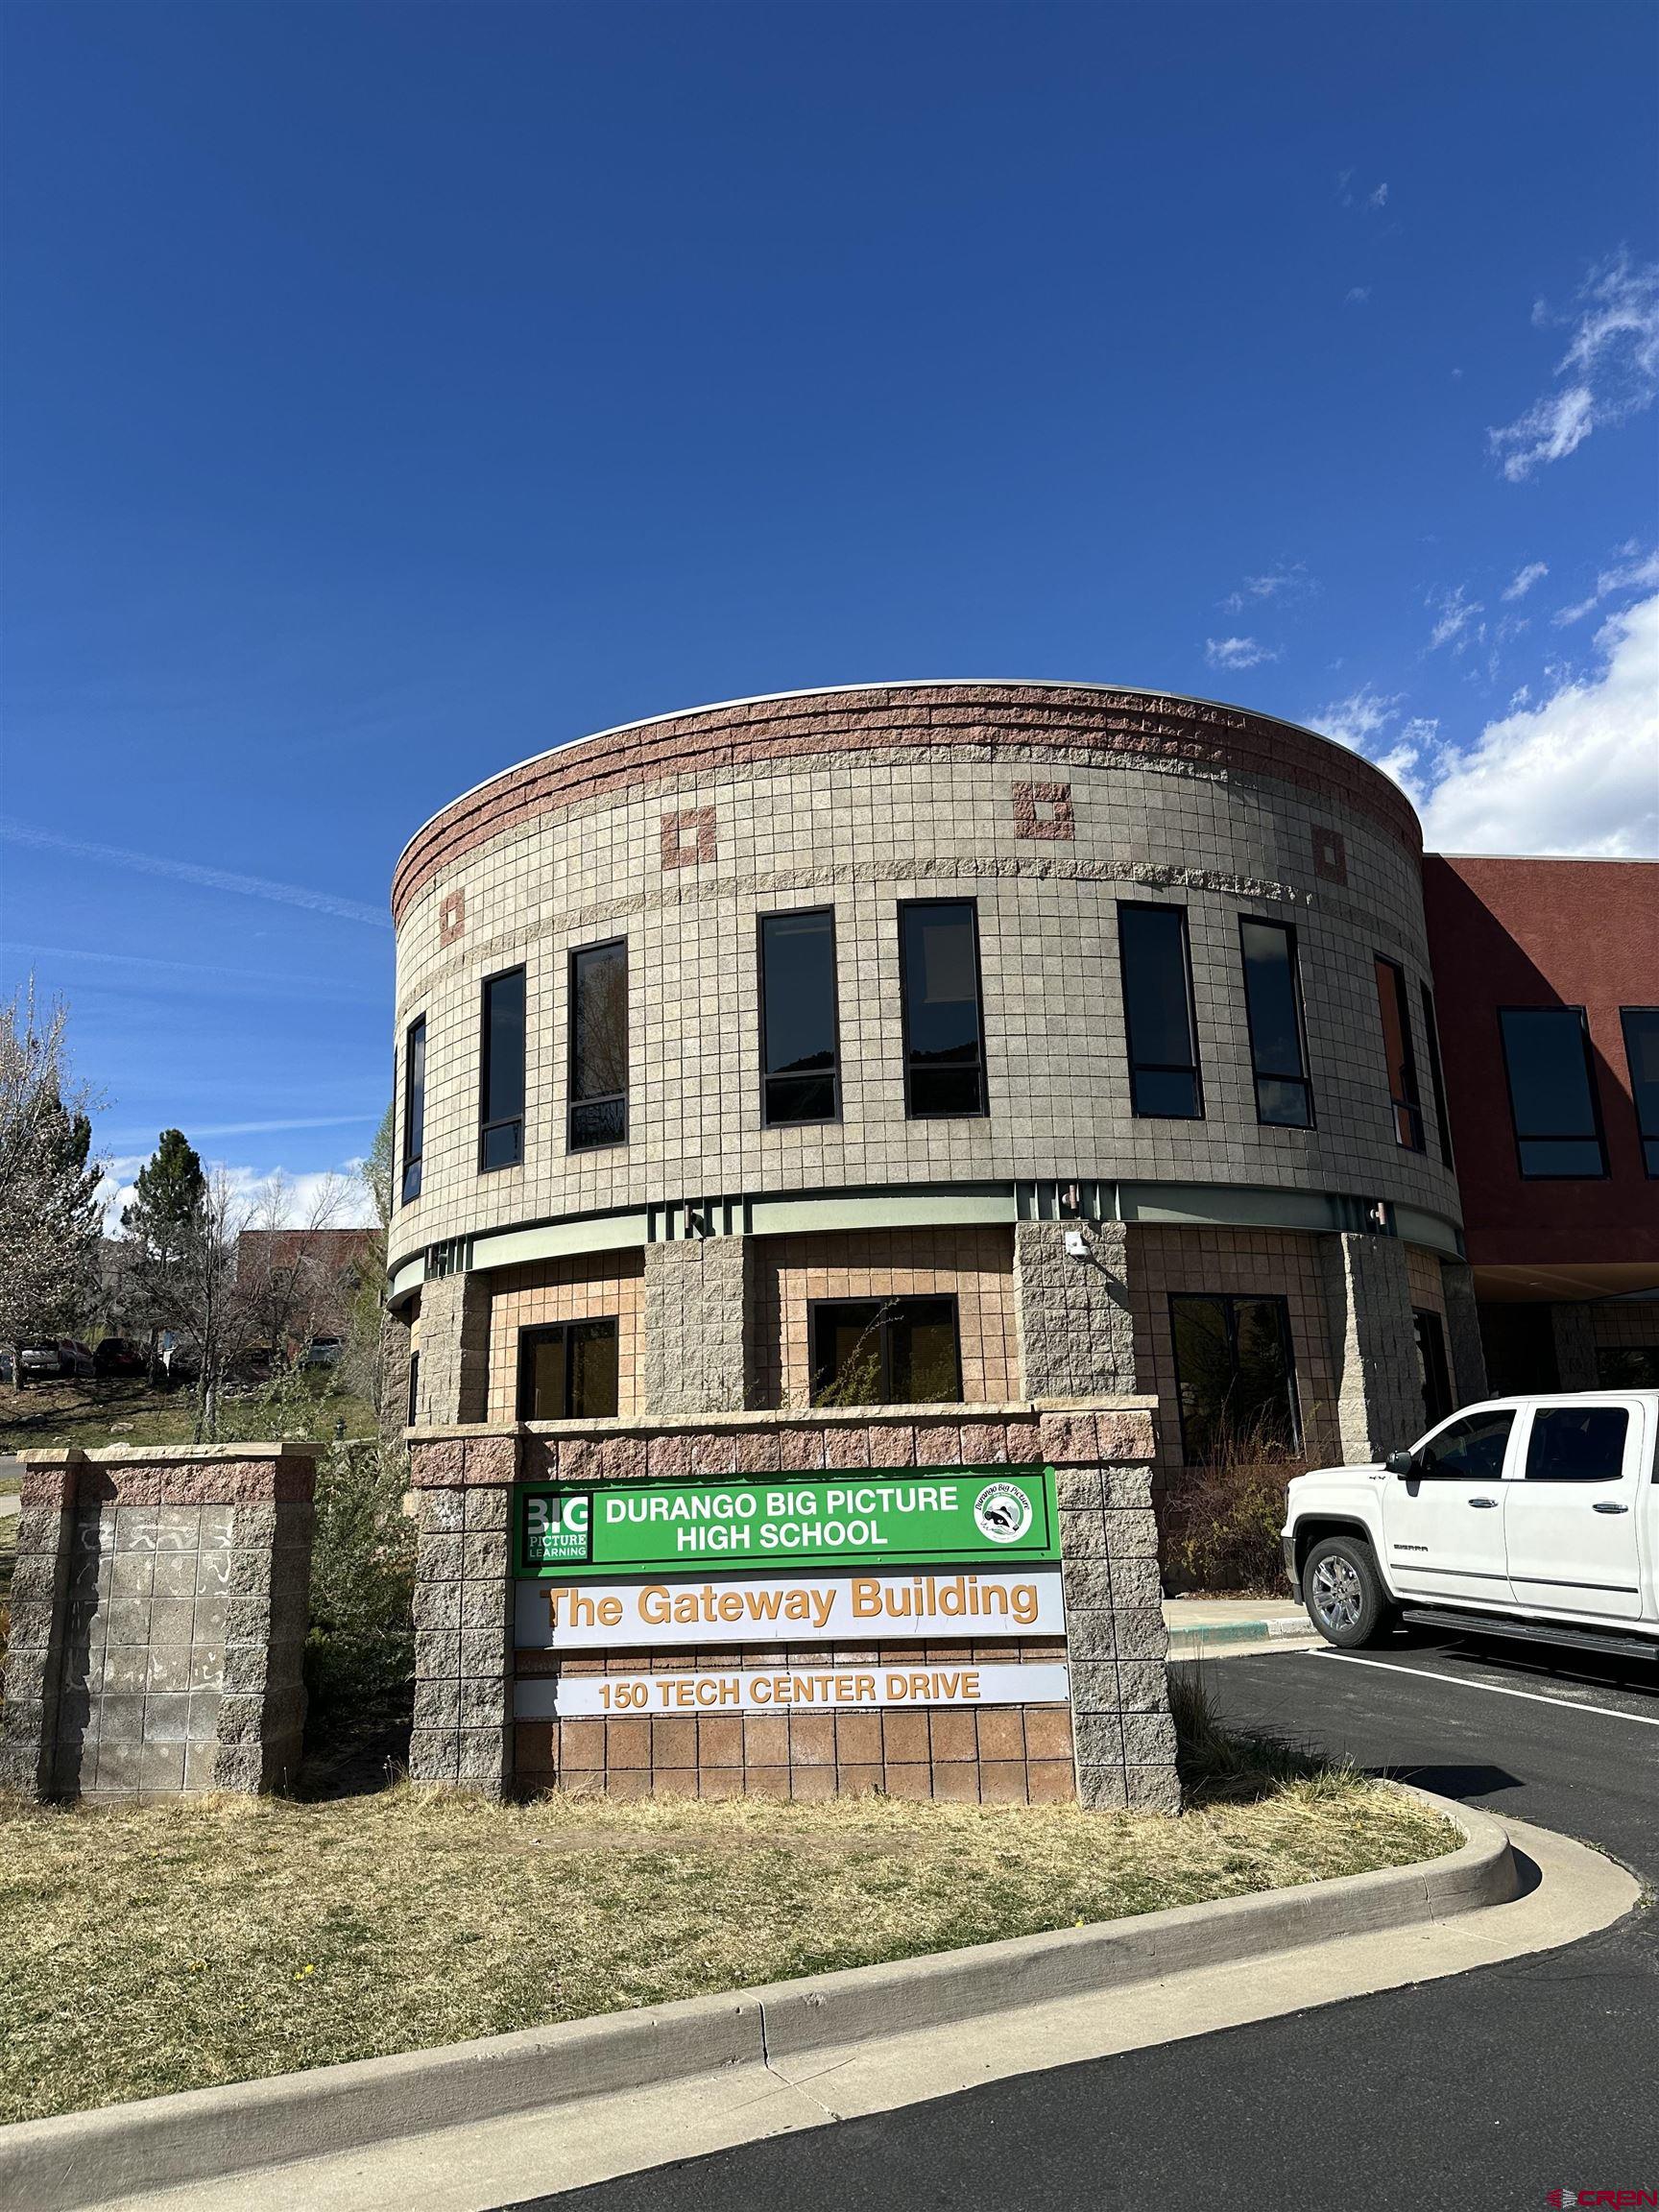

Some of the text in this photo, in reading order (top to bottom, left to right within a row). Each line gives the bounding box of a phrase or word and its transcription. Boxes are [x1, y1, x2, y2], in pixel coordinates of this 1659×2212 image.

[528, 1497, 589, 1534] BIG
[606, 1486, 959, 1524] DURANGO BIG PICTURE
[530, 1534, 587, 1547] PICTURE
[530, 1547, 586, 1557] LEARNING
[677, 1520, 888, 1551] HIGH SCHOOL
[540, 1575, 1039, 1627] The Gateway Building
[598, 1671, 981, 1709] 150 TECH CENTER DRIVE
